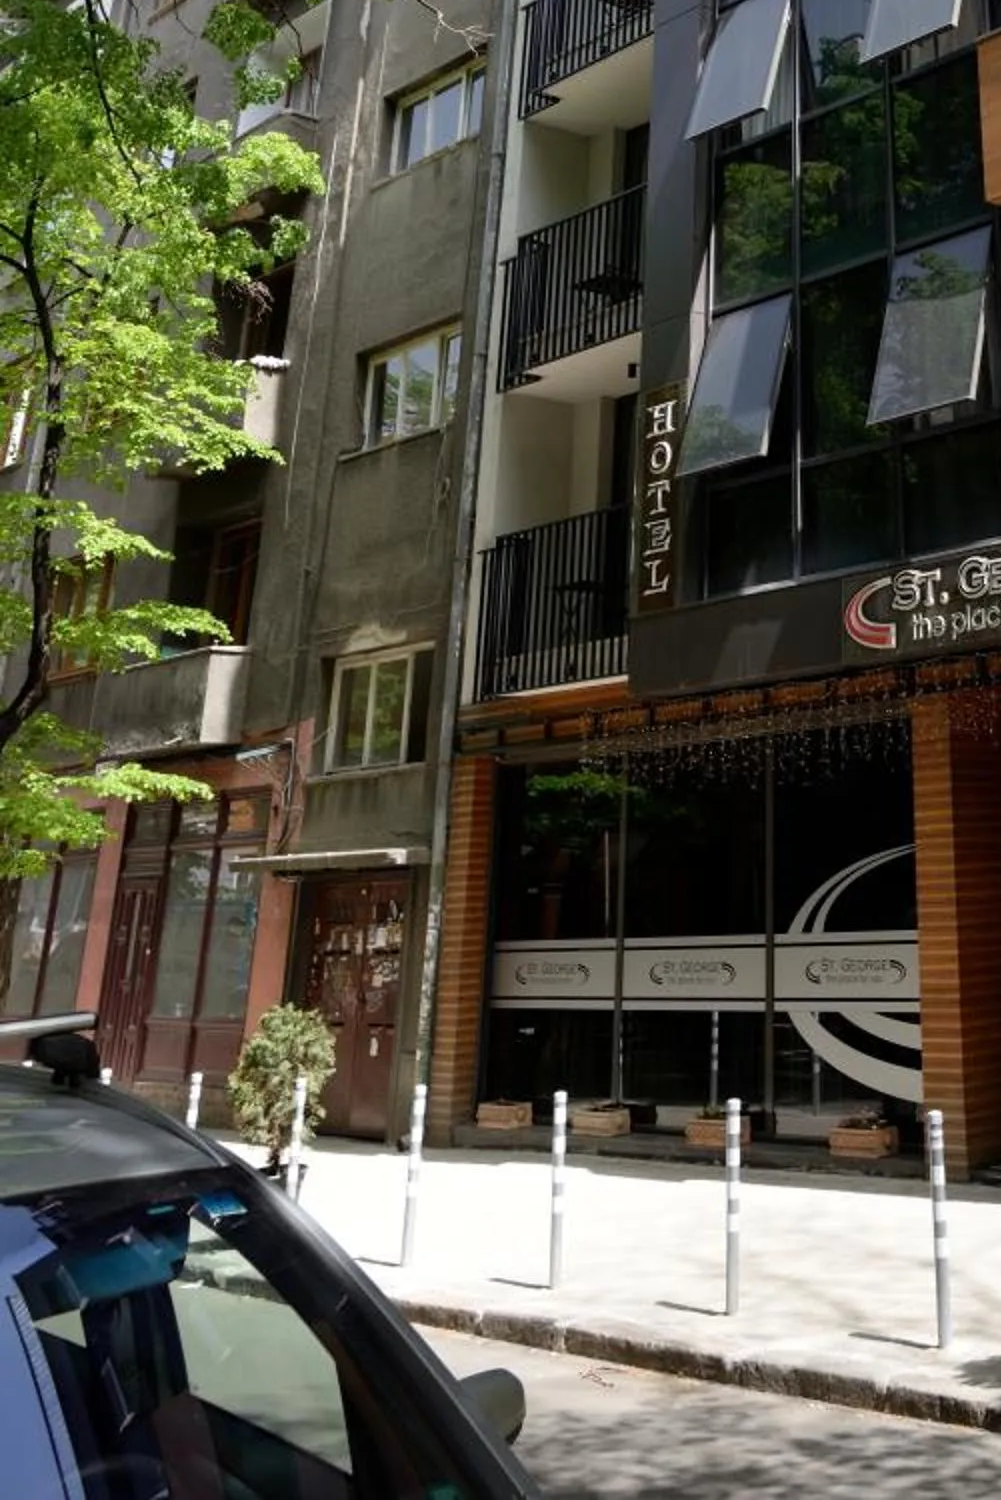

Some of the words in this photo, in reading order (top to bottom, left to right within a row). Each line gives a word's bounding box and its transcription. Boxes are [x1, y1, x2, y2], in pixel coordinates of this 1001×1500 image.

[644, 400, 678, 596] HOTEL
[891, 568, 949, 611] ST.
[911, 612, 946, 640] the
